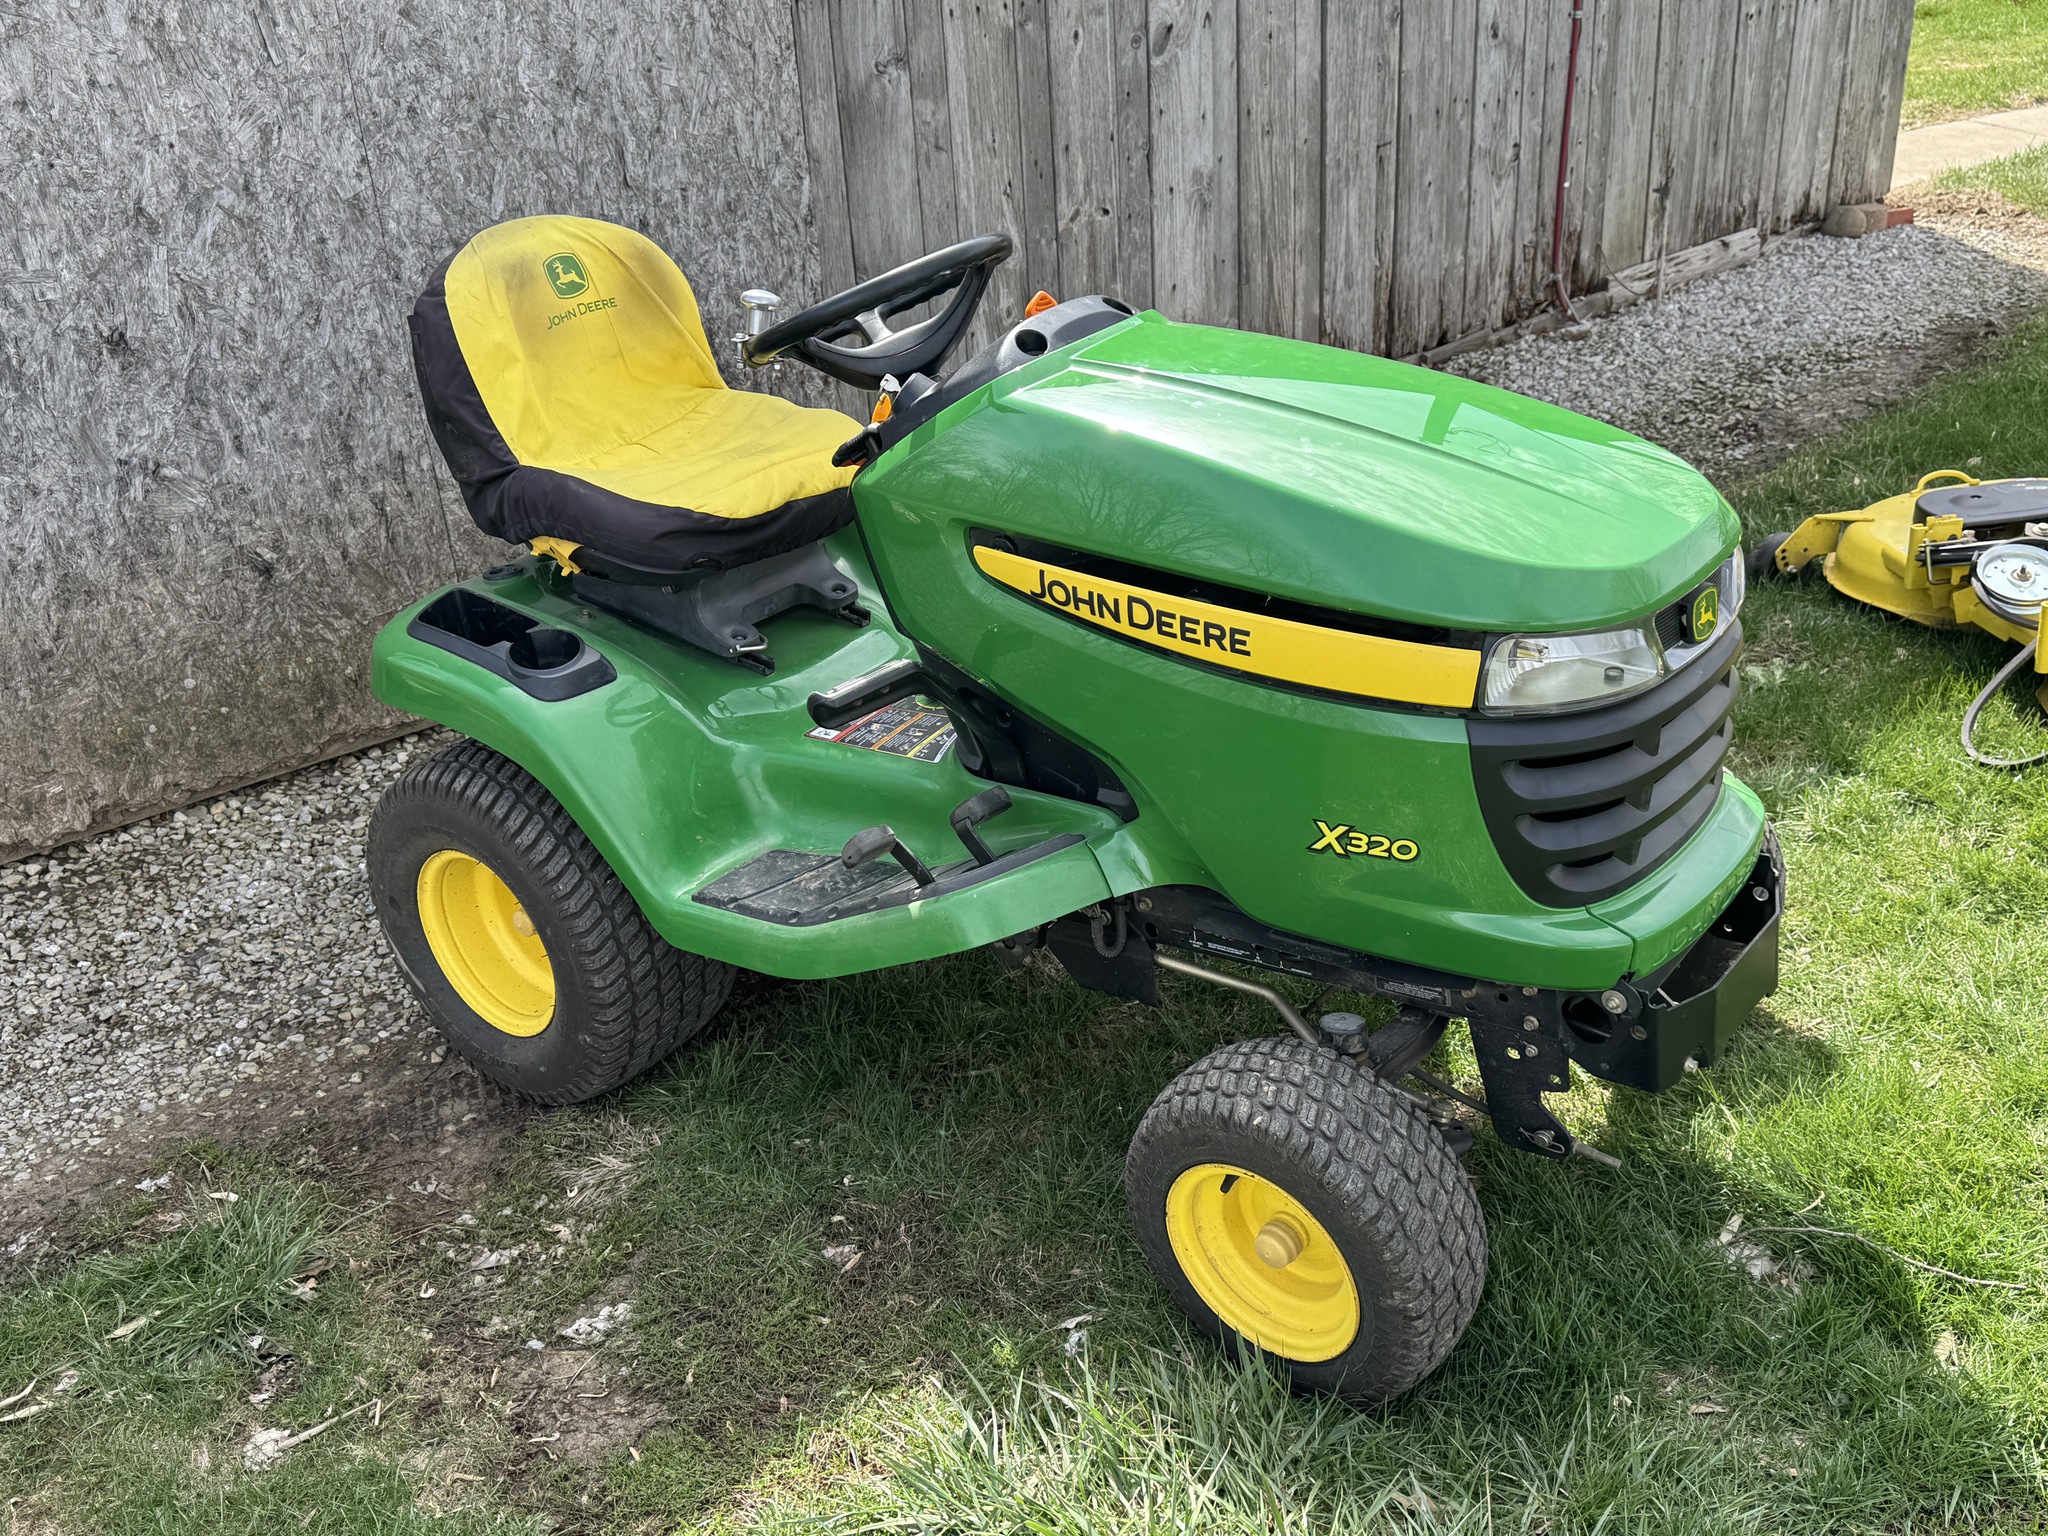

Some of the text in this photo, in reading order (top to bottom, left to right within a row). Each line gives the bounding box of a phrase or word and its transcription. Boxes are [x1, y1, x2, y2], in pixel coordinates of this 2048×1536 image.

[547, 297, 618, 330] JOHN DEERE
[1030, 569, 1251, 656] JOHN DEERE
[1305, 818, 1420, 862] X320
